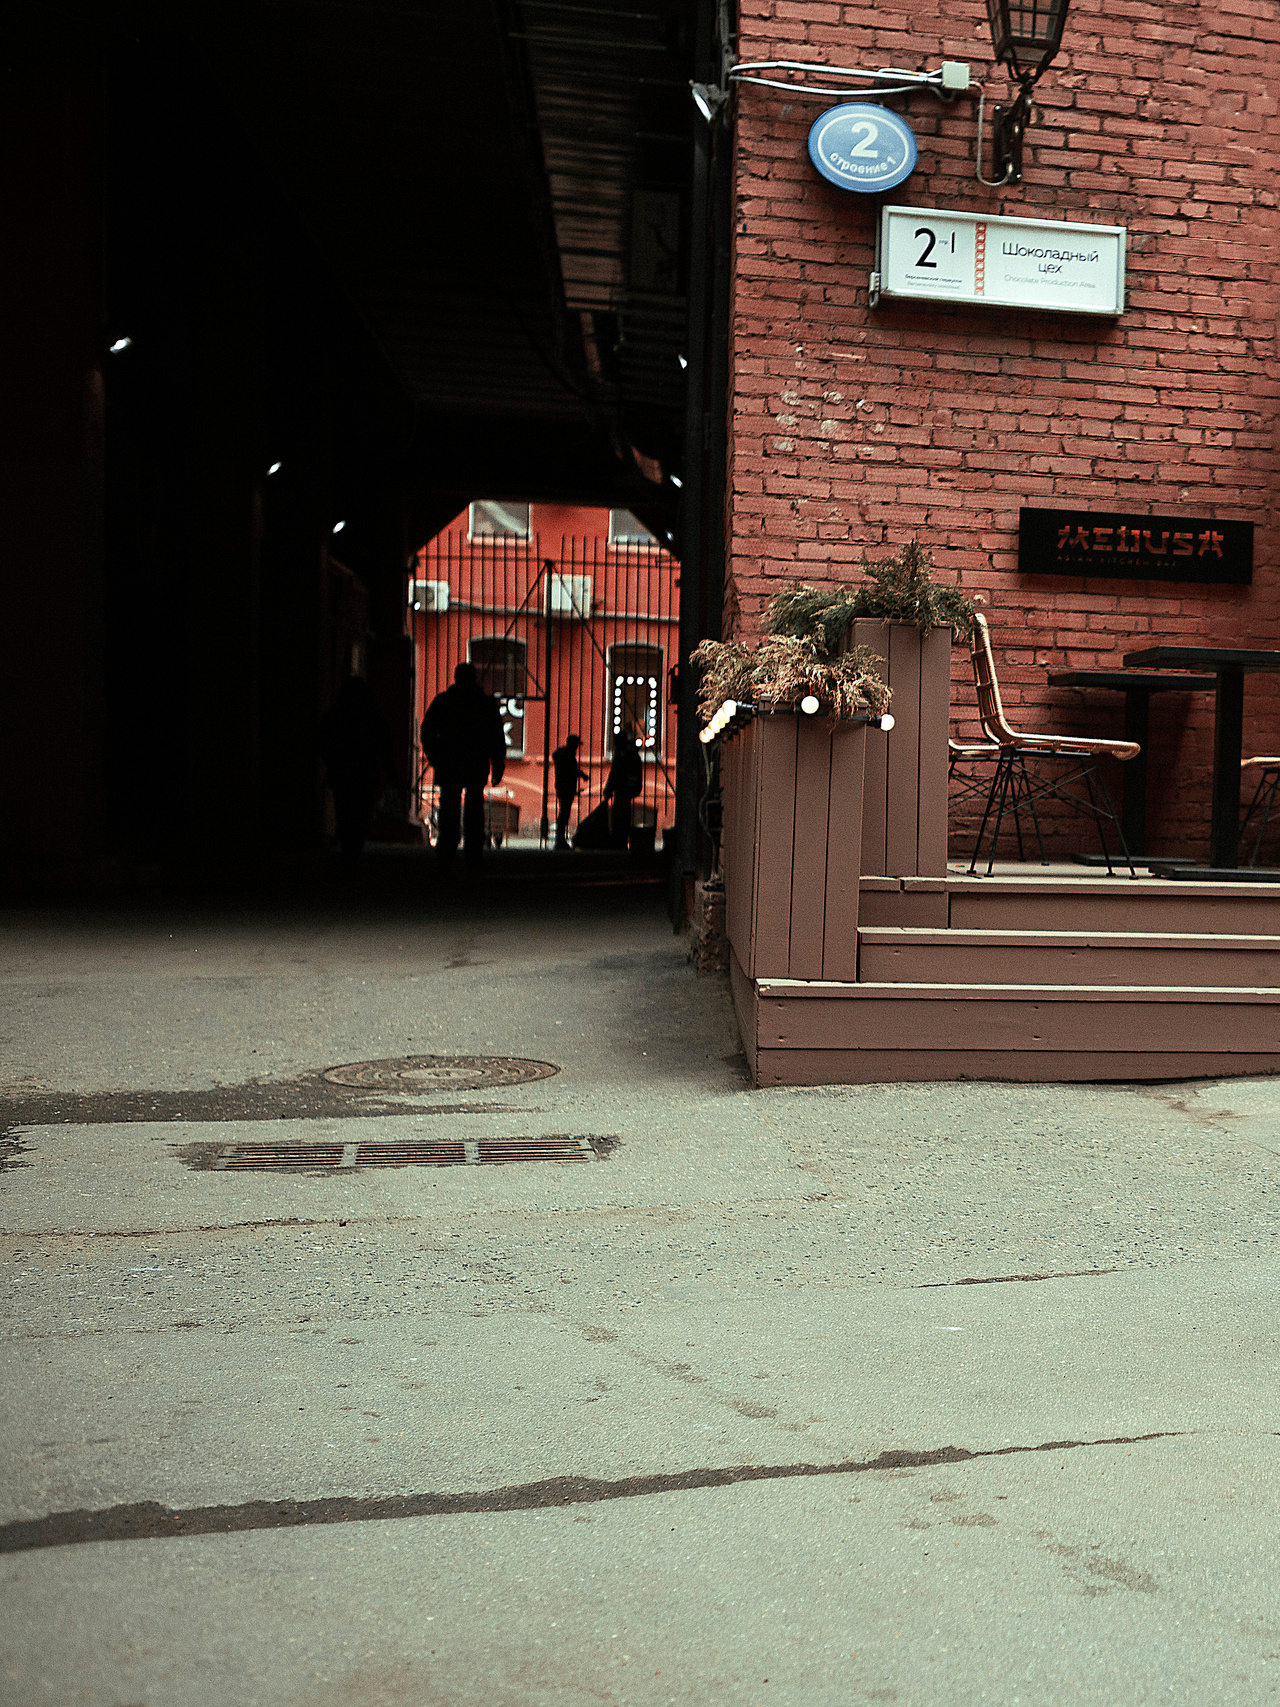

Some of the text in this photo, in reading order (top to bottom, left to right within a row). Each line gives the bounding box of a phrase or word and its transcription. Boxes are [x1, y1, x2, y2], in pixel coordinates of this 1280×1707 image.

[850, 121, 878, 158] 2
[830, 153, 896, 174] строение 1
[914, 227, 937, 268] 2
[1002, 242, 1099, 262] Шоколадный
[1038, 263, 1063, 274] цех
[1040, 277, 1078, 288] Production
[1057, 525, 1225, 558] MEDUSA
